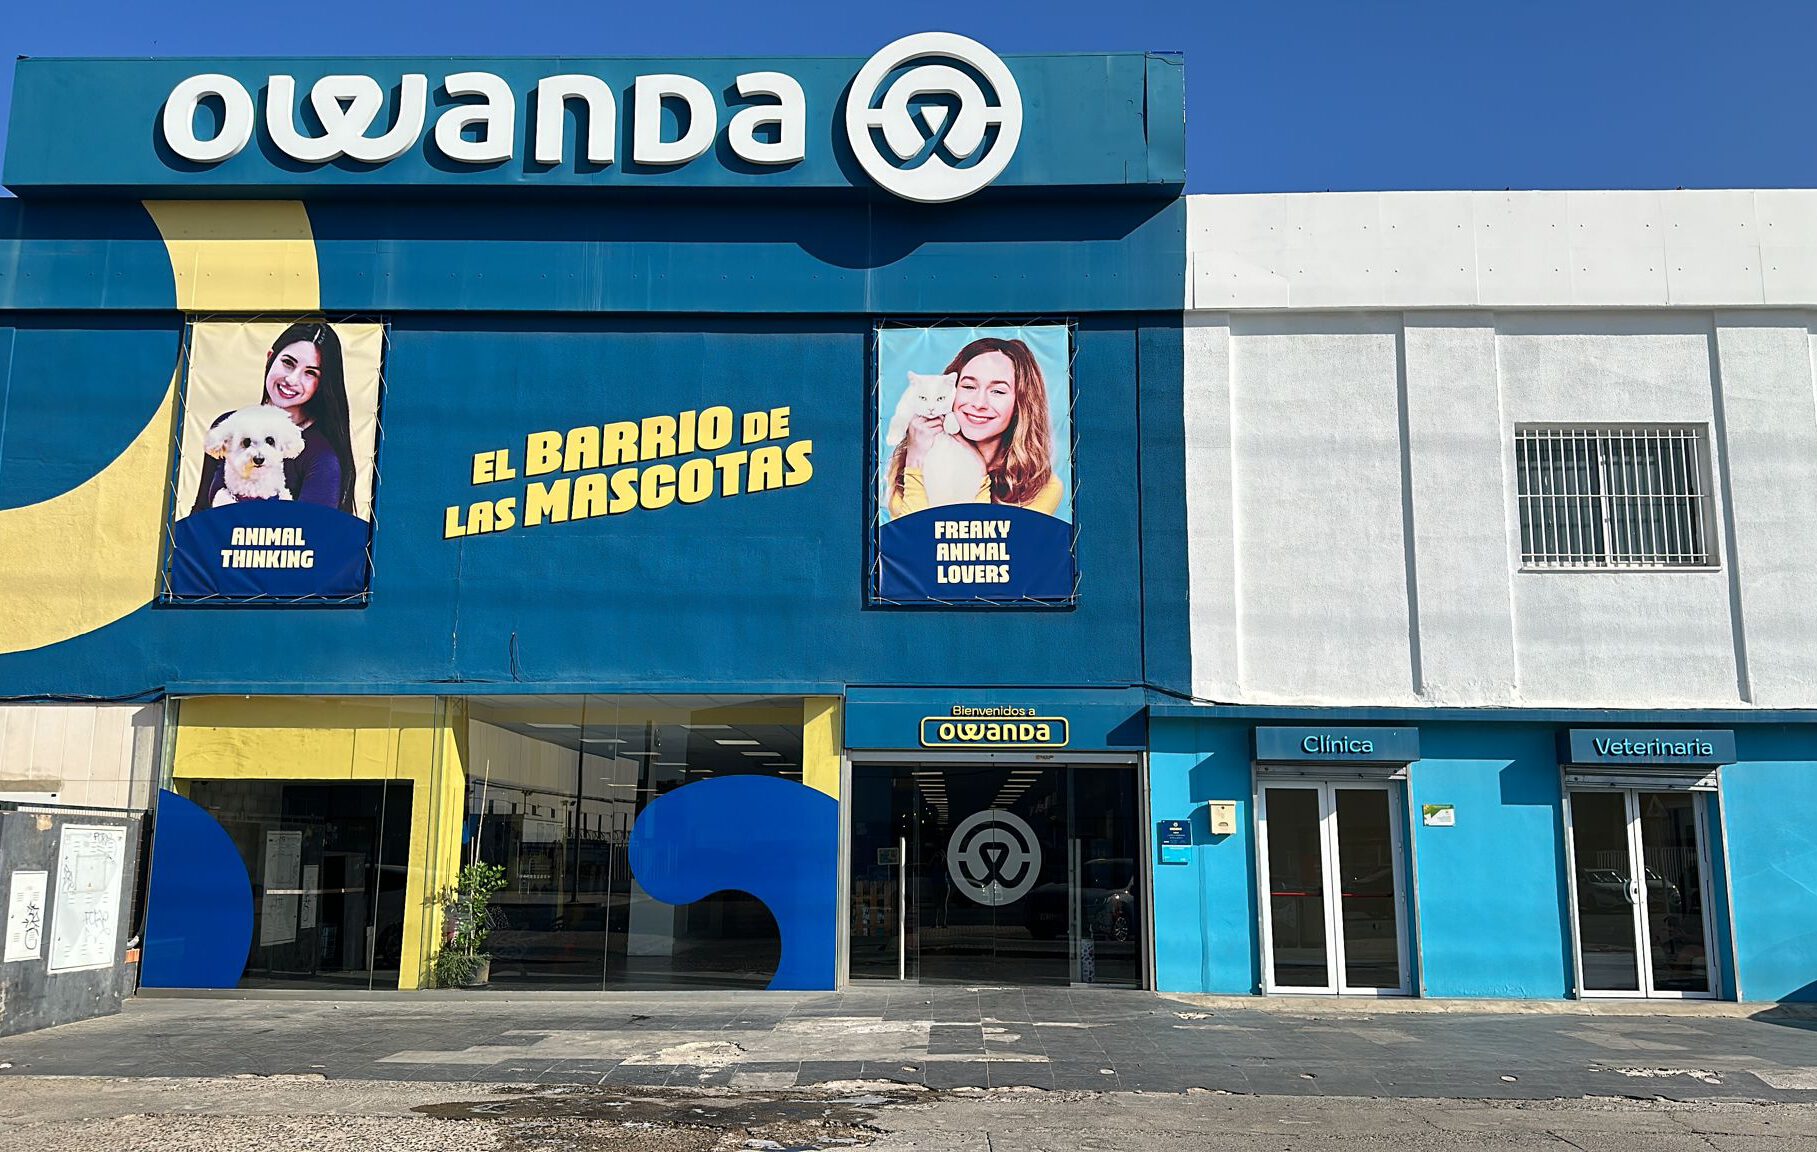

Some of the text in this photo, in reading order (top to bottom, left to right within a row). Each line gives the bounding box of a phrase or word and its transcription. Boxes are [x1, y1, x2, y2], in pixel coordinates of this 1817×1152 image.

[472, 405, 791, 485] EL BARRIO DE
[444, 440, 814, 539] LAS MASCOTAS
[231, 527, 306, 546] ANIMAL
[934, 520, 1011, 539] FREAKY
[221, 550, 314, 569] THINKING
[936, 542, 1010, 561] ANIMAL
[937, 564, 1010, 584] LOVERS
[952, 705, 1036, 716] Bienvenidos a
[1303, 734, 1374, 753] Clínica
[1595, 737, 1713, 755] Veterinaria
